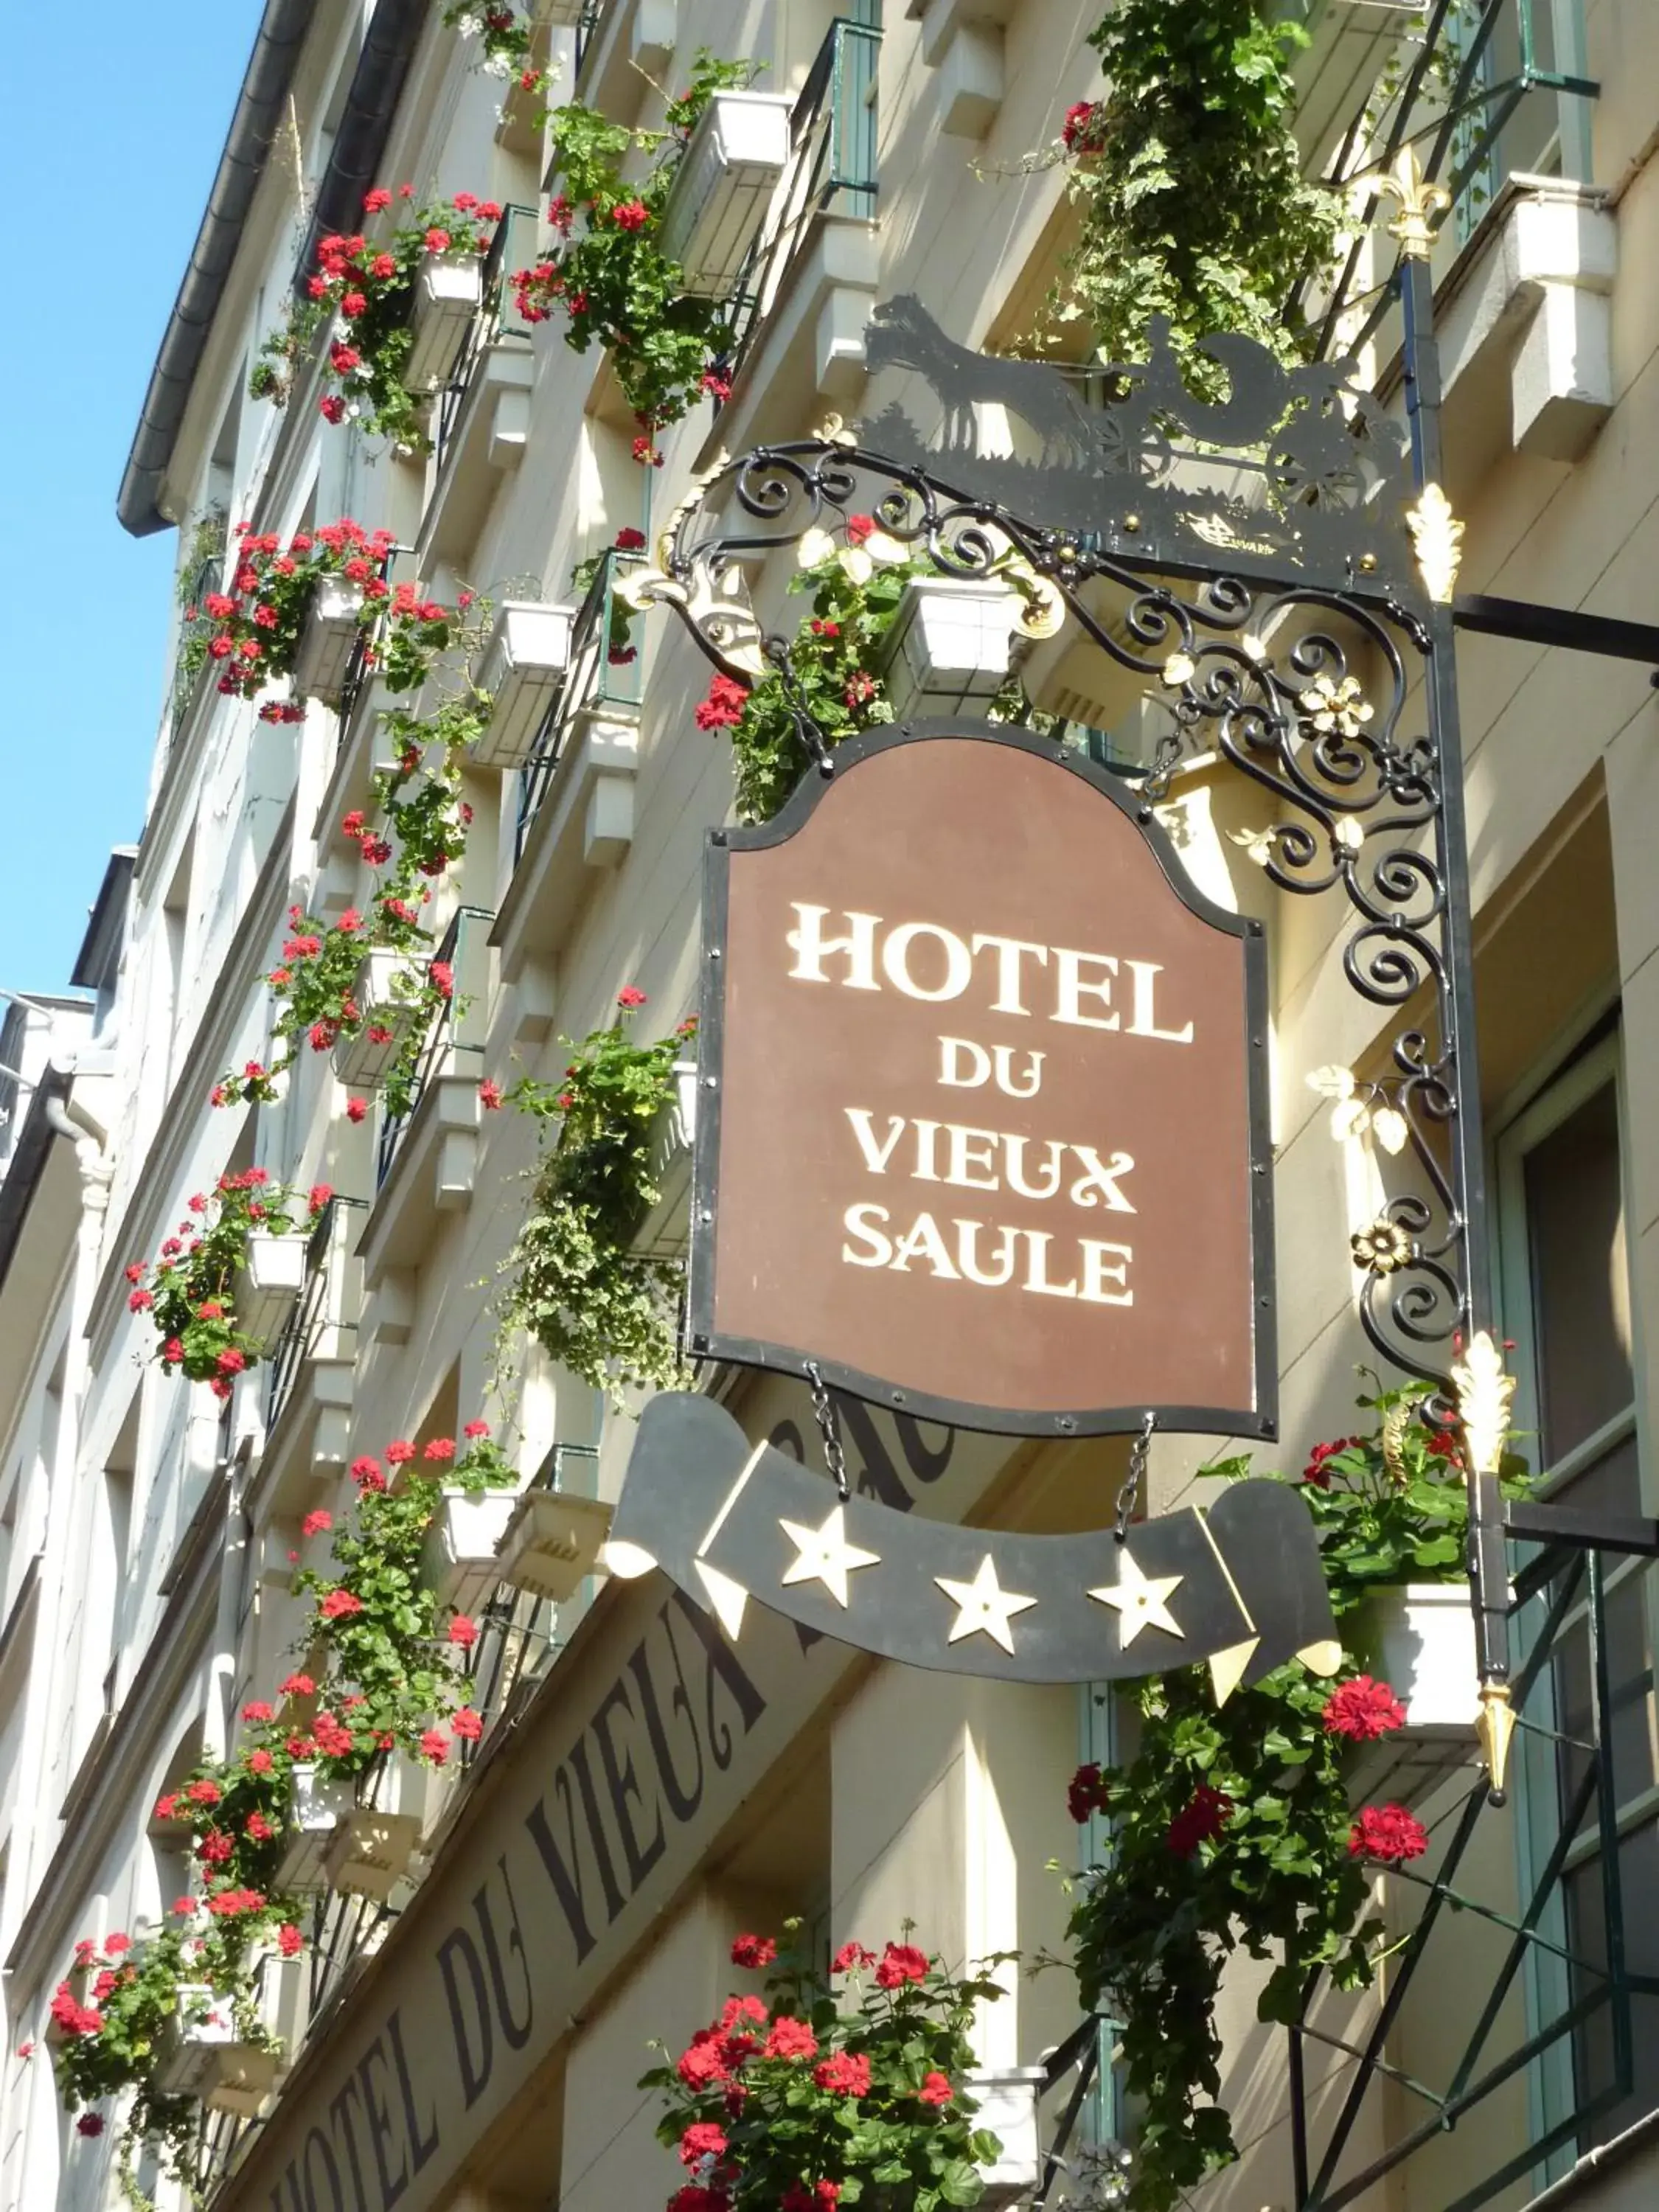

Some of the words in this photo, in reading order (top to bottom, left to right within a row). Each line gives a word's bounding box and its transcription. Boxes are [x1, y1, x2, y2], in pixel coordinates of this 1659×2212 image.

[786, 902, 1193, 1043] HOTEL
[937, 1035, 1046, 1098] DU
[843, 1108, 1137, 1214] VIEUX
[842, 1203, 1133, 1307] SAULE
[436, 1853, 533, 2111] DU
